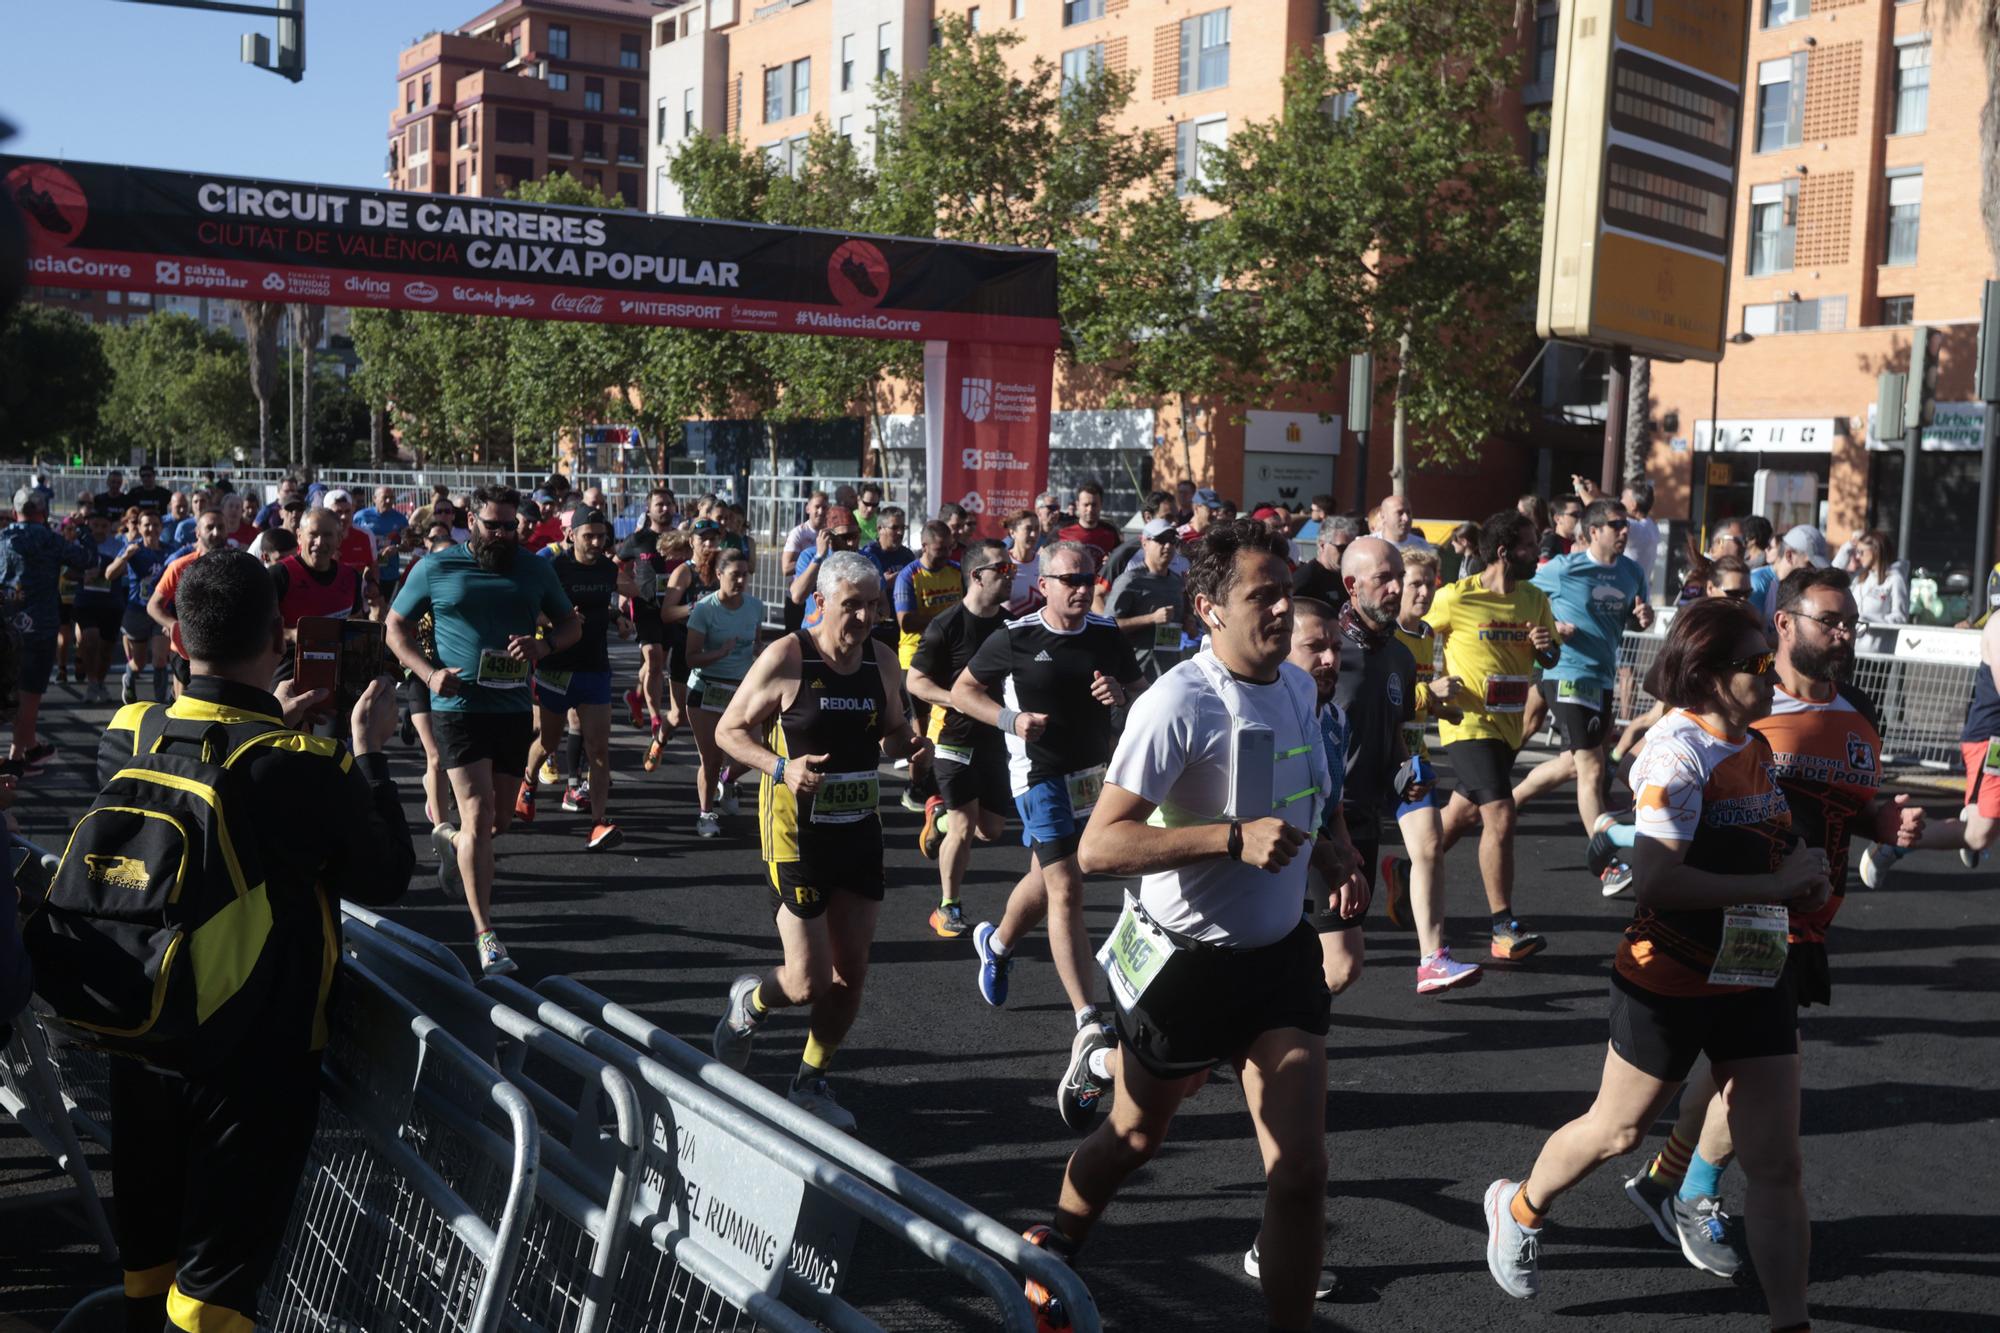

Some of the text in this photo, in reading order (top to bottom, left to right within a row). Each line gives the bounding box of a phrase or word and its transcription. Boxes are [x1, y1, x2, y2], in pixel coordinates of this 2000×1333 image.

[198, 183, 607, 246] CIRCUIT DE CARRERES
[198, 222, 459, 264] CIUTAT DE VALÈNCIA
[184, 263, 226, 277] caixa
[184, 273, 249, 290] popular
[287, 278, 331, 288] TRINIDAD
[344, 276, 391, 293] divina
[287, 286, 331, 297] ALFONSO
[466, 288, 493, 302] Corte
[634, 301, 723, 319] INTERSPORT
[741, 309, 779, 319] aspaym
[795, 310, 922, 333] #ValènciaCorre
[1935, 412, 1984, 427] Urban
[984, 450, 1015, 462] caixa
[984, 458, 1031, 472] popular
[986, 496, 1029, 508] TRINIDAD
[1803, 765, 1829, 783] DE
[823, 781, 869, 804] 4333
[1707, 807, 1762, 827] QUART
[1121, 919, 1154, 973] 4545
[704, 1195, 777, 1271] RUNNING
